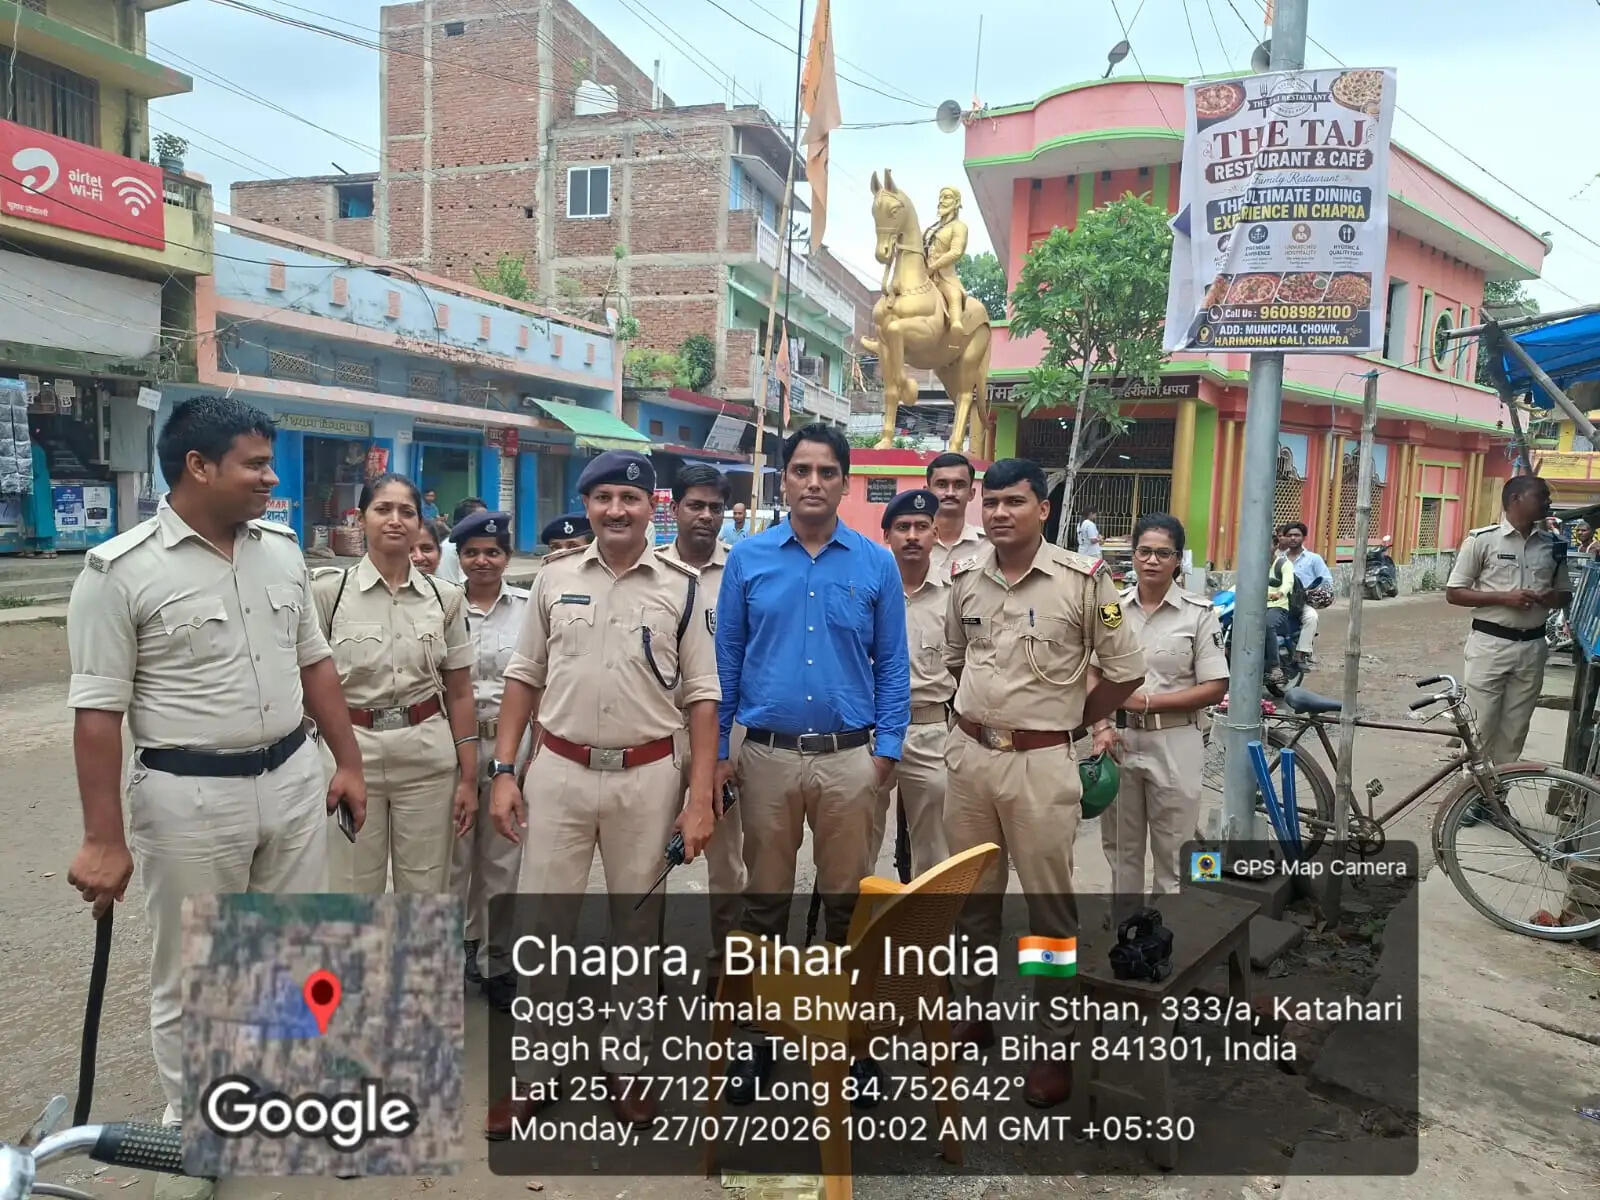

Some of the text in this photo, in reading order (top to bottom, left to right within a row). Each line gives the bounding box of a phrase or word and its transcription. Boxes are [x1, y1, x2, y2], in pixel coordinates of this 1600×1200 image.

[1281, 94, 1327, 102] RESTAURANT
[1213, 119, 1367, 159] THE TAJ
[1315, 152, 1326, 166] &
[1331, 150, 1366, 168] CAFÉ
[68, 168, 103, 188] airtel
[1253, 171, 1340, 185] Family Restaurant
[69, 182, 103, 202] Wi-Fi
[1244, 188, 1309, 206] ULTIMATE
[1312, 188, 1362, 203] DINING
[1213, 203, 1366, 231] EXPRIENCE IN CHAPRA
[1225, 308, 1241, 318] Call
[1260, 305, 1352, 320] 9608982100
[1219, 324, 1340, 336] ADD: MUNICIPAL CHOWK,
[1214, 335, 1349, 347] HARIMOHAN GALI, CHAPRA
